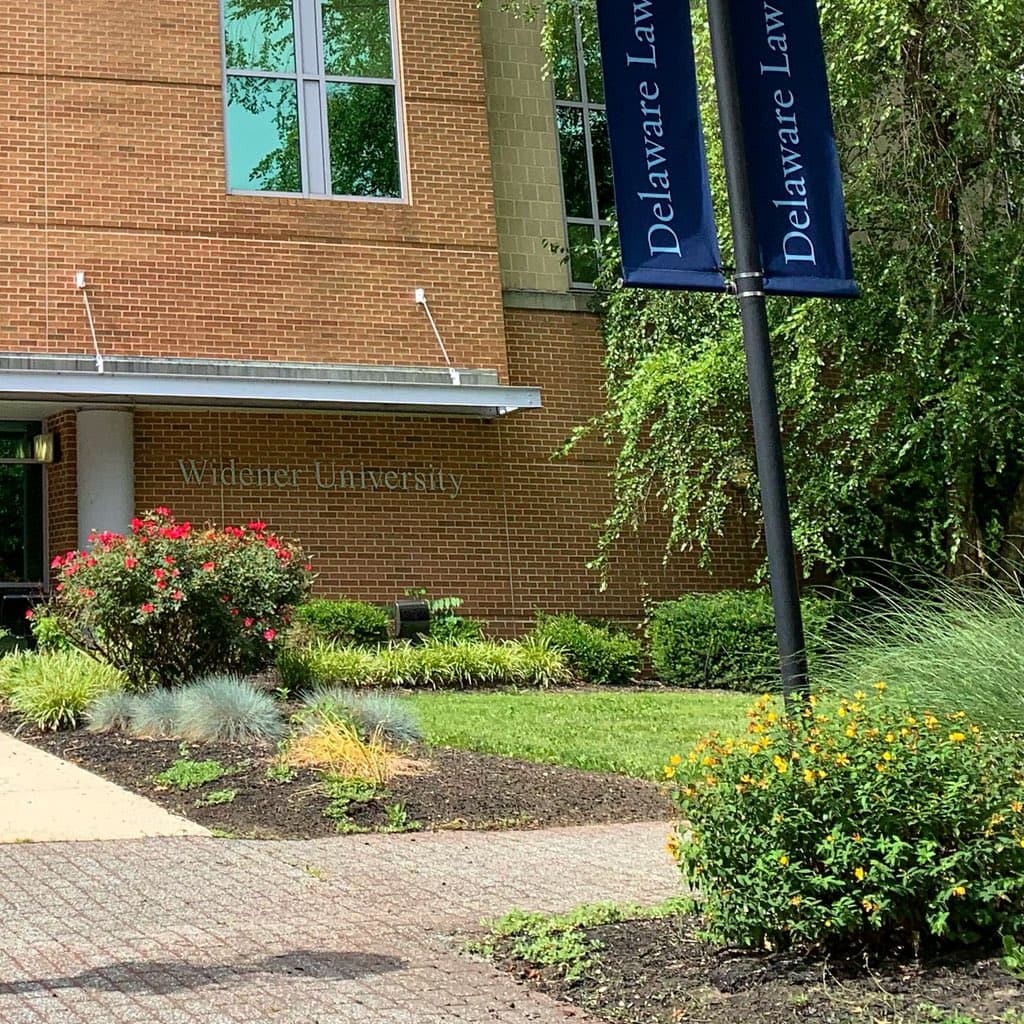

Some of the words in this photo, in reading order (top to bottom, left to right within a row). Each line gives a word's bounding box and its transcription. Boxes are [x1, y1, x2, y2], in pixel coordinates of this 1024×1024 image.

[760, 1, 792, 77] Law
[637, 81, 682, 258] Delaware
[772, 89, 817, 266] Delaware
[177, 458, 302, 487] Widener
[313, 460, 465, 499] University
